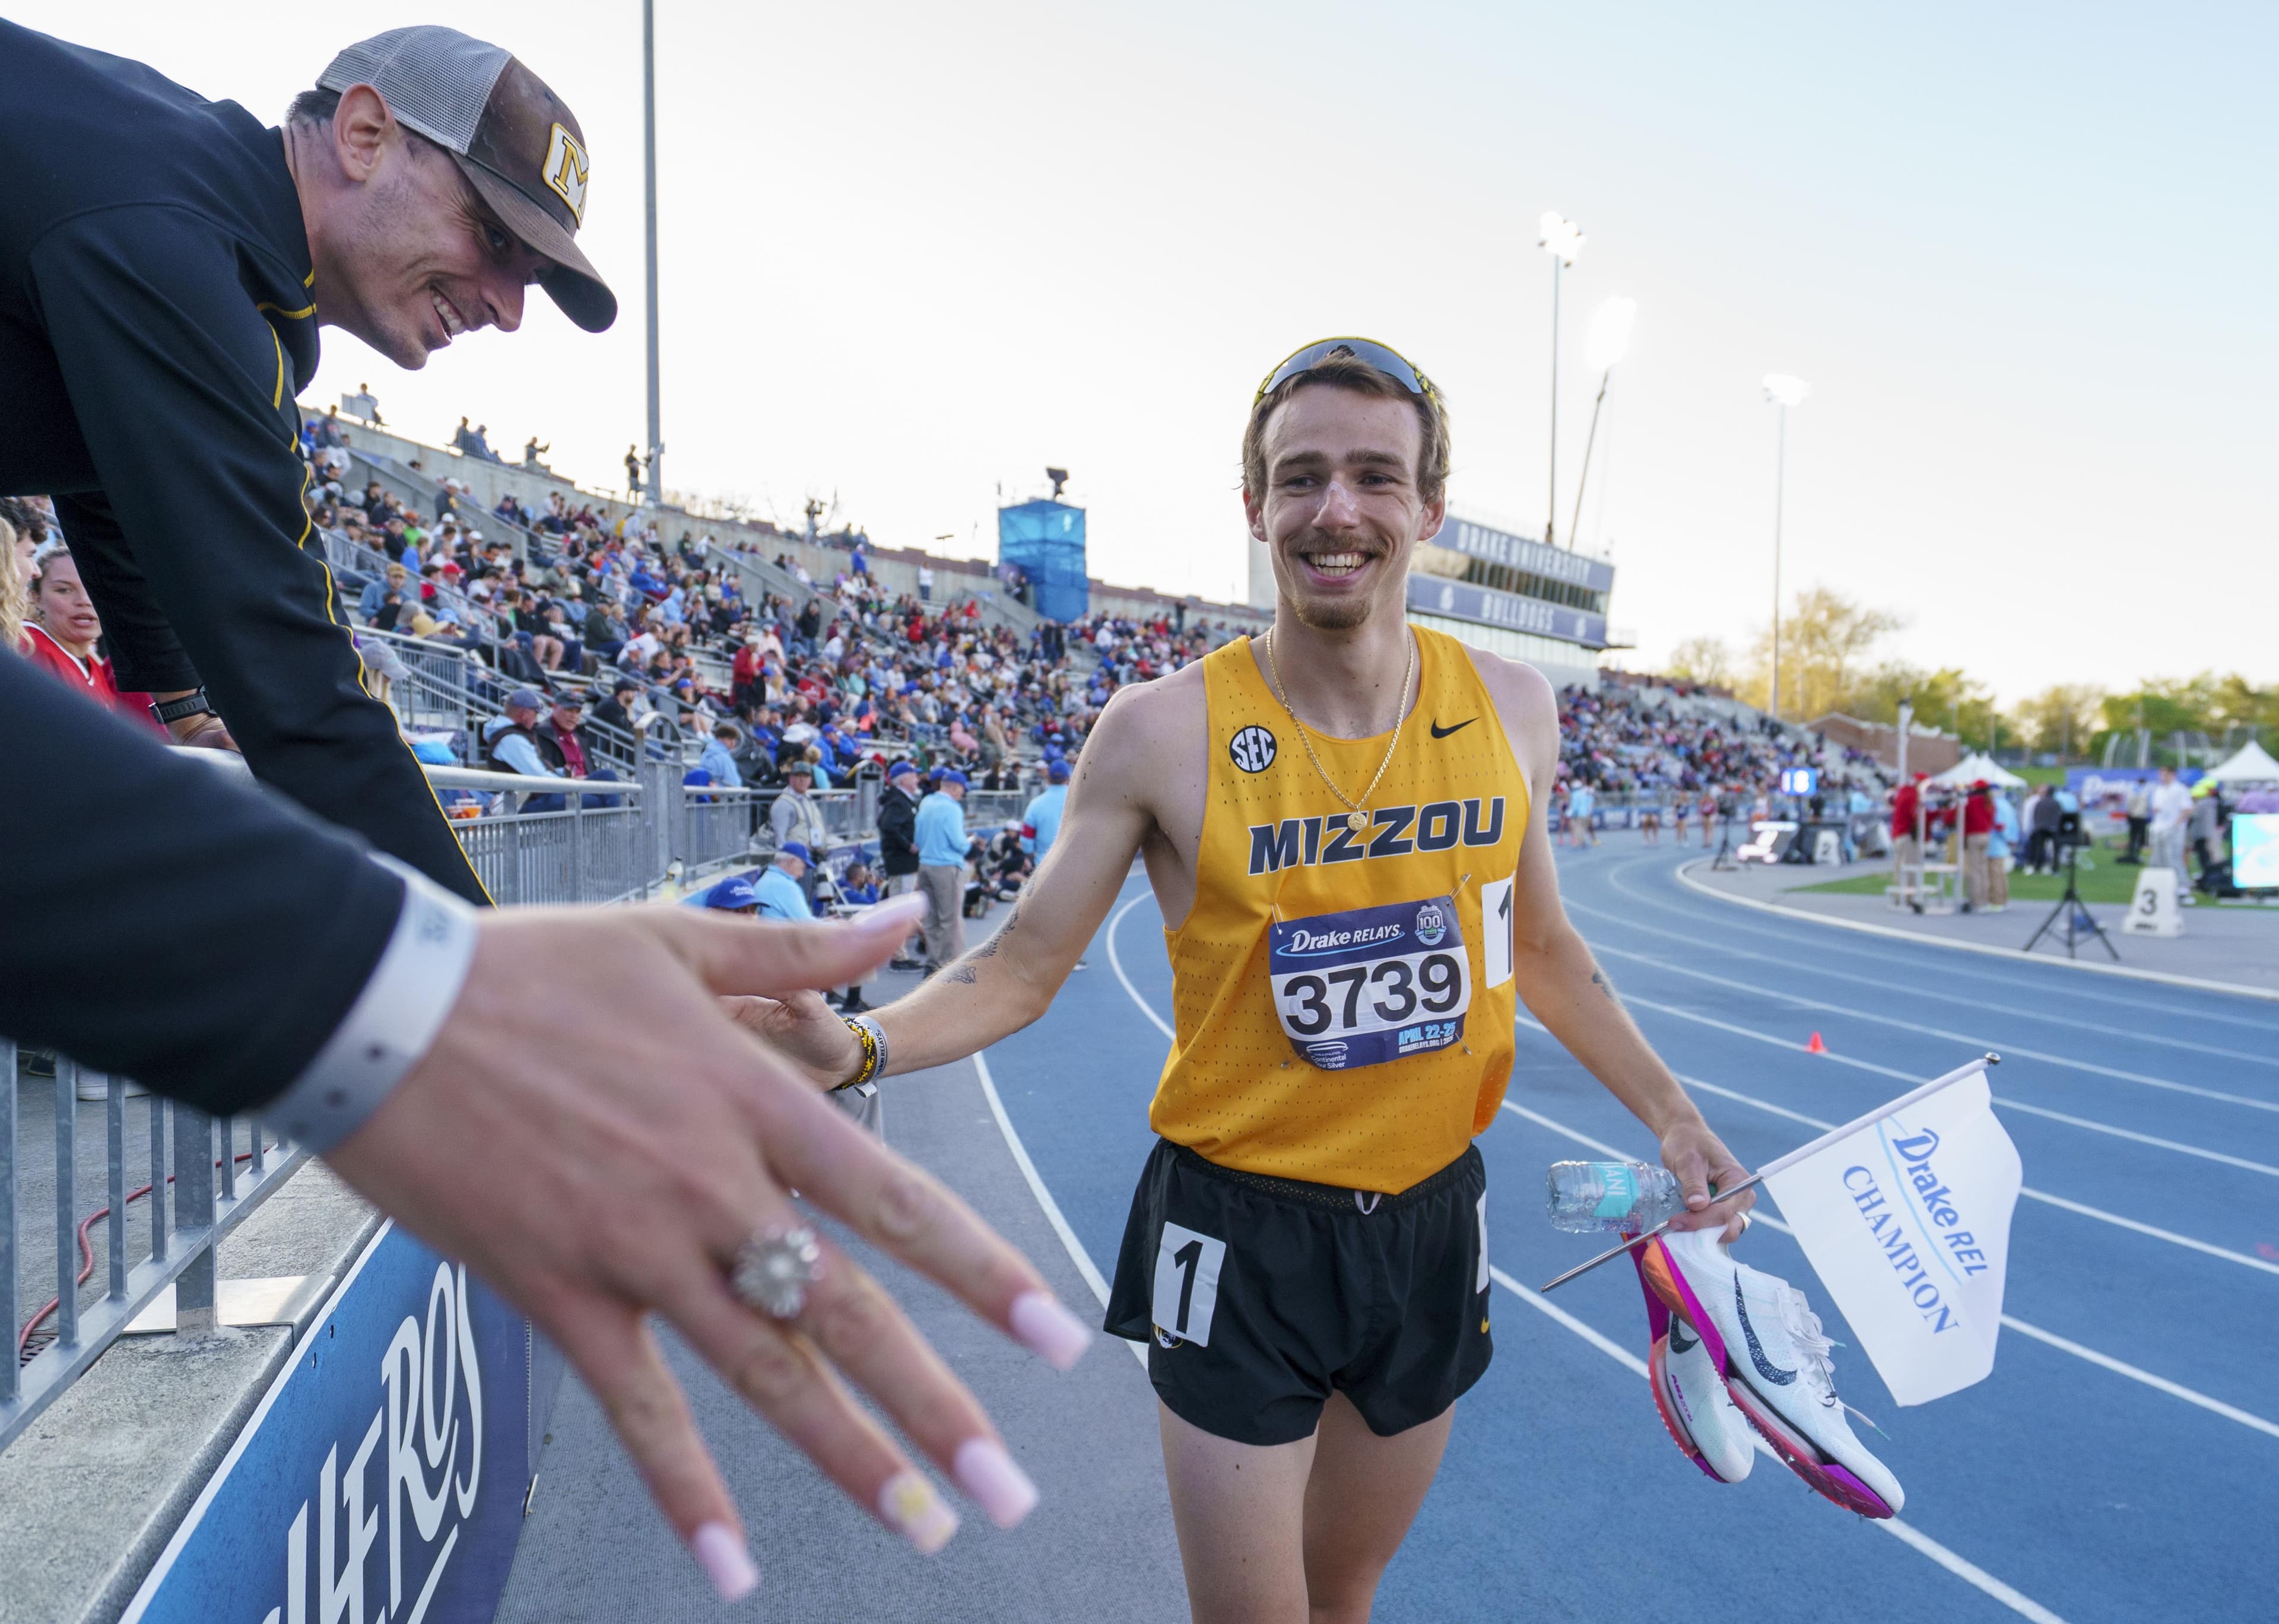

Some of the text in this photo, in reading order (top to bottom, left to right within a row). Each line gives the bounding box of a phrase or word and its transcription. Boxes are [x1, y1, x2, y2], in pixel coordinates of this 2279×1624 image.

[1456, 523, 1592, 584] DRAKE UNIVERSITY
[1482, 593, 1554, 631] BULLDOGS
[1232, 727, 1274, 771] SEC
[1248, 796, 1506, 876] MIZZOU
[1419, 915, 1441, 930] 100
[2139, 889, 2157, 916] 3
[1290, 924, 1401, 953] Drake RELAYS
[1498, 883, 1512, 975] 1
[1283, 954, 1461, 1035] 3739
[1311, 1053, 1347, 1063] Continental
[1398, 1021, 1456, 1045] APRIL 22-25
[1892, 1127, 1959, 1228] Drake
[1843, 1165, 1960, 1334] CHAMPION
[1174, 1240, 1204, 1334] 1
